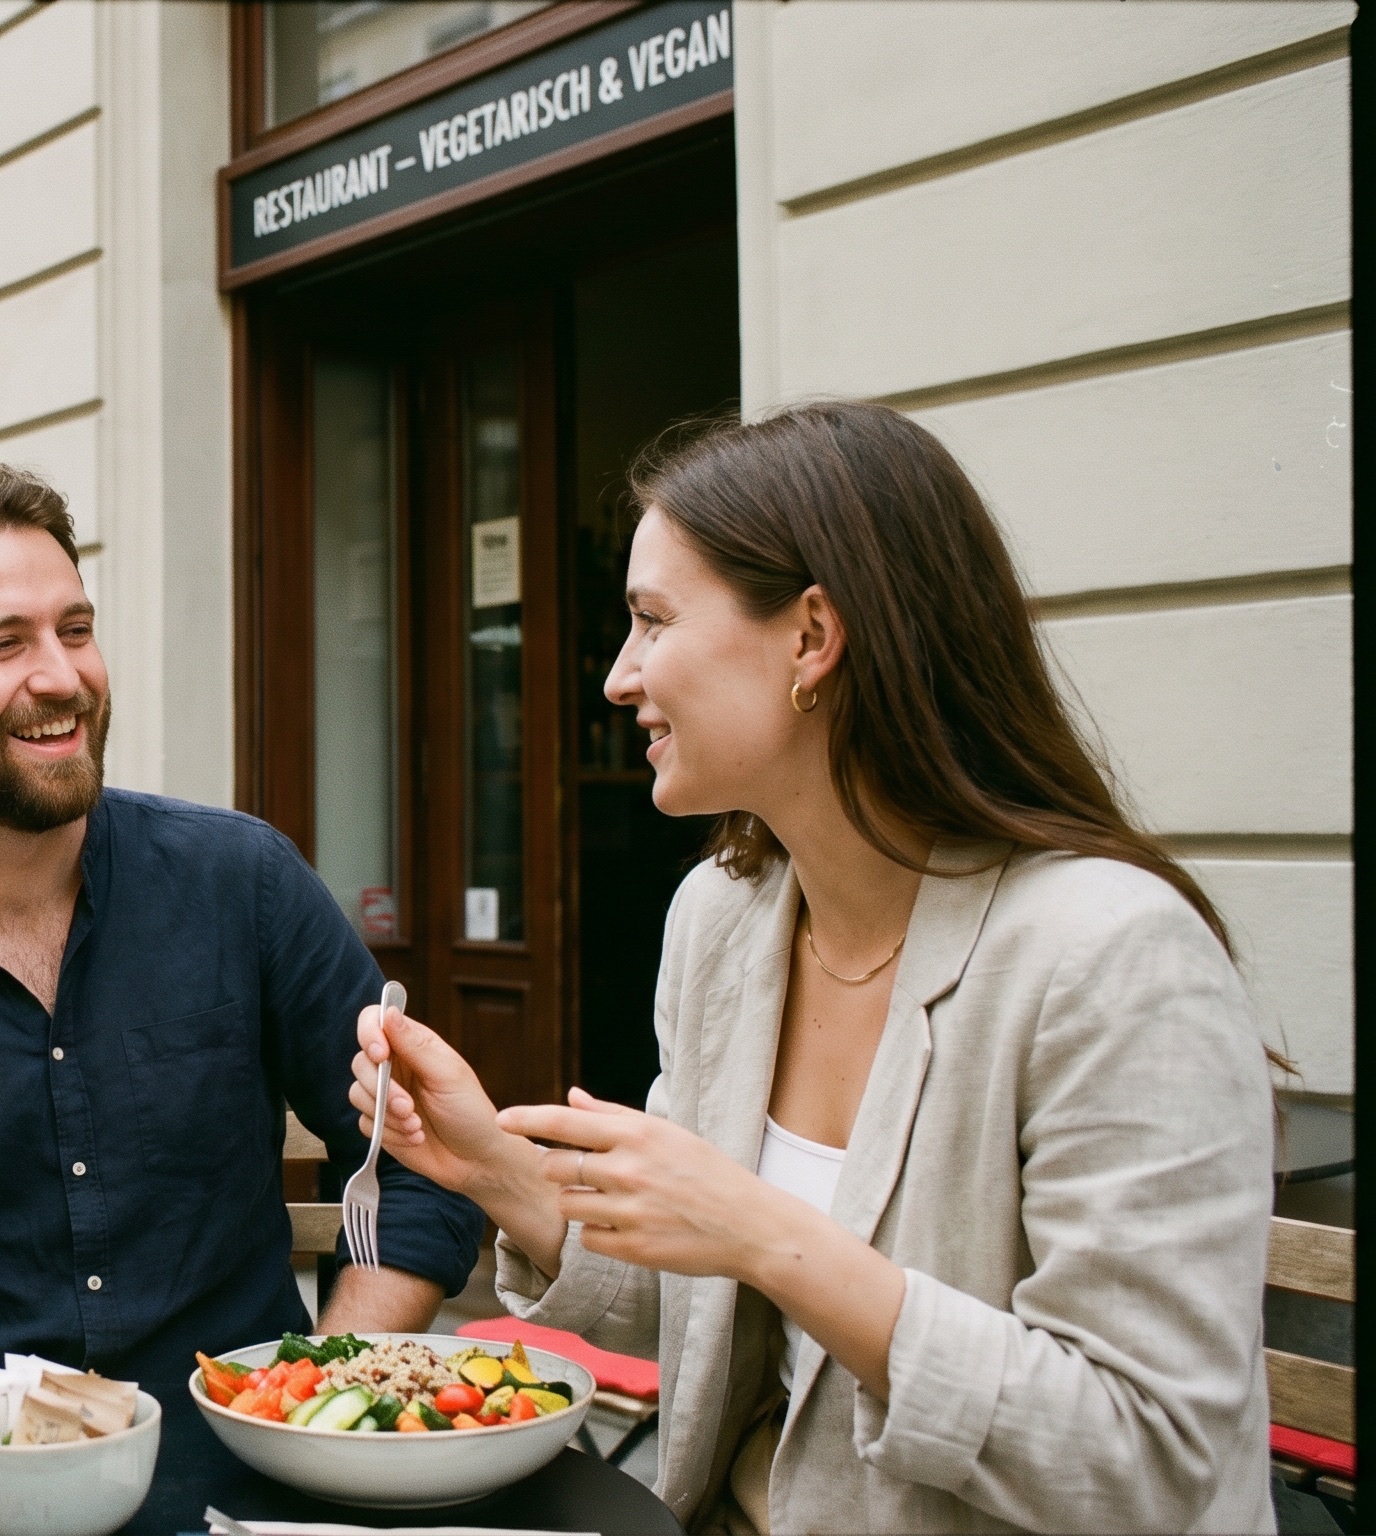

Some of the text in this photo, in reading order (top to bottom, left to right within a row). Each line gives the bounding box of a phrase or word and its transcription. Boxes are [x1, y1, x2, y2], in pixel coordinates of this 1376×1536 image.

[254, 145, 391, 236] RESTAURANT
[419, 65, 590, 172] VEGETARISCH
[598, 57, 623, 104] &
[628, 9, 730, 92] VEGAN
